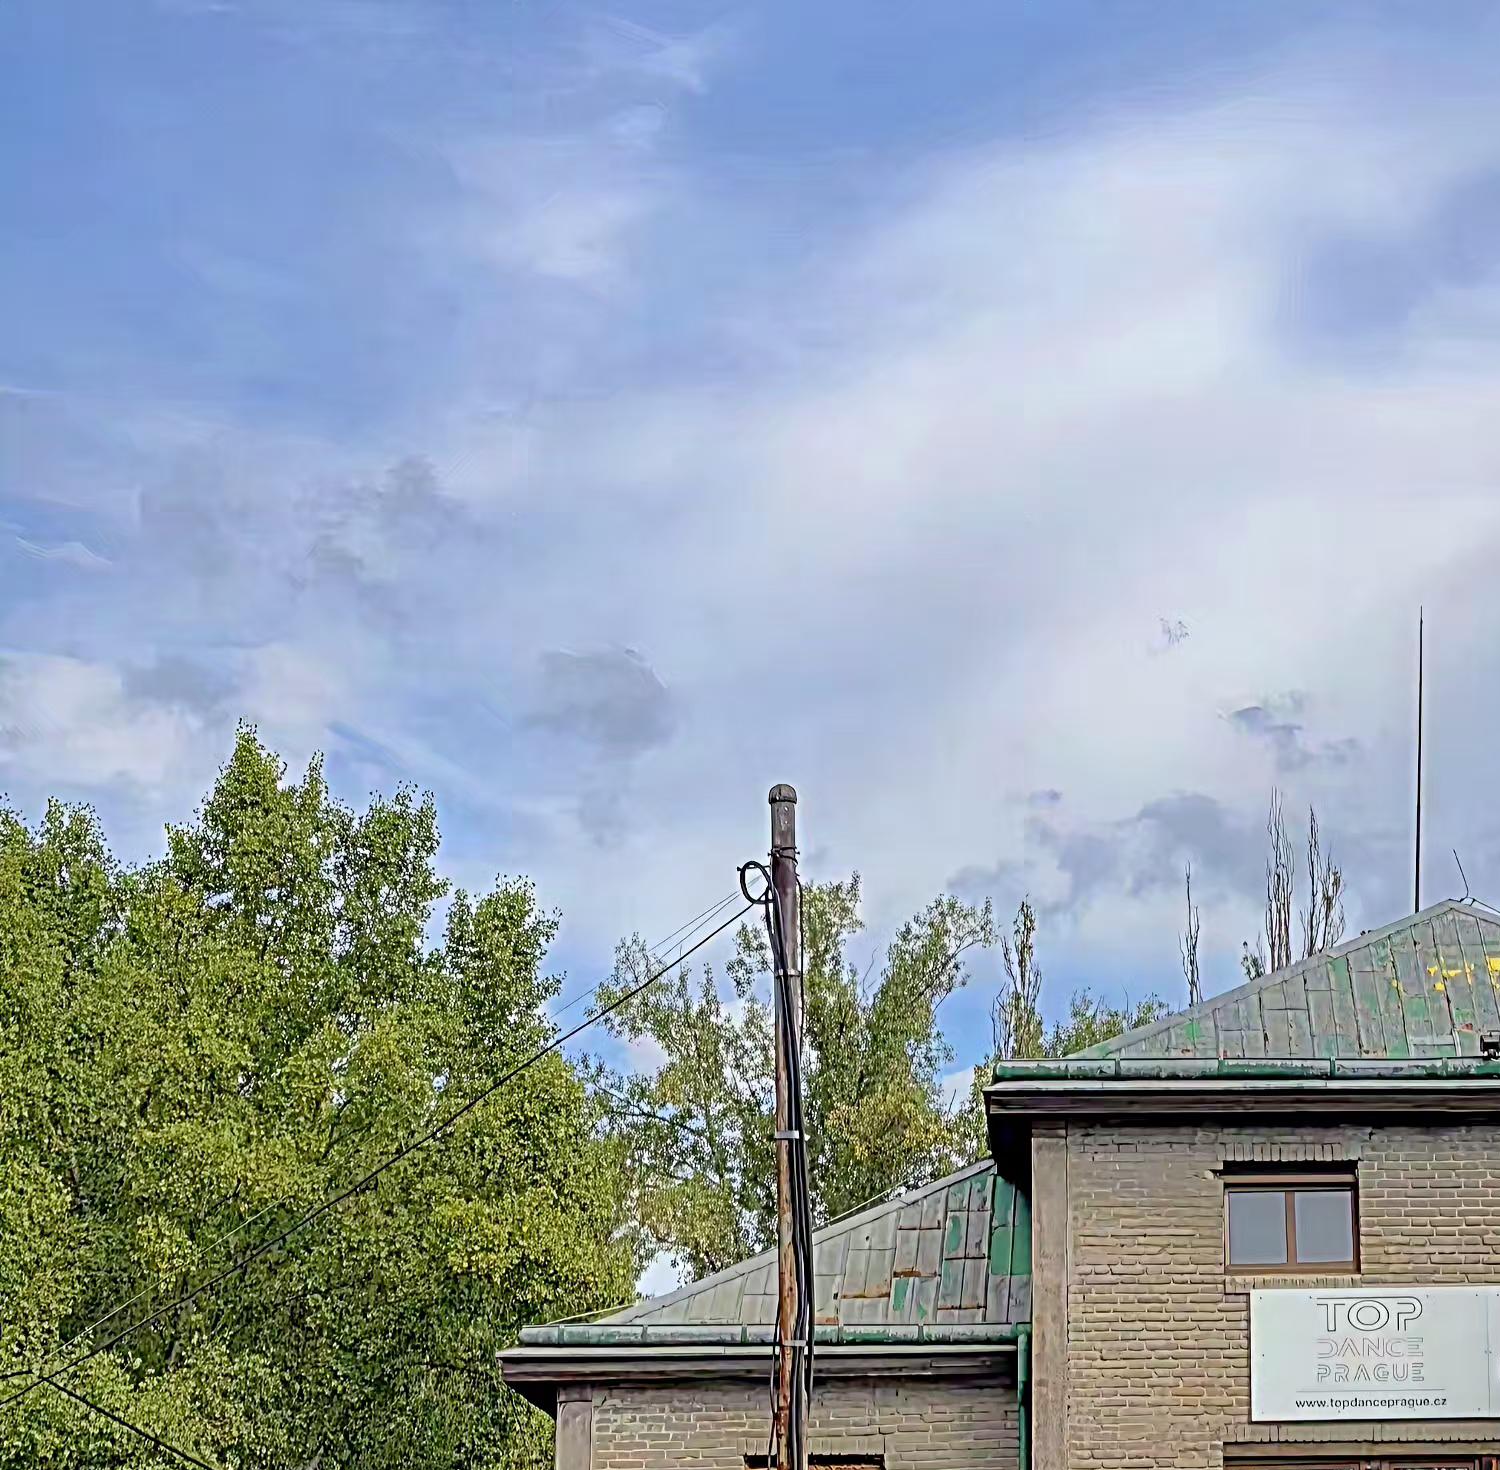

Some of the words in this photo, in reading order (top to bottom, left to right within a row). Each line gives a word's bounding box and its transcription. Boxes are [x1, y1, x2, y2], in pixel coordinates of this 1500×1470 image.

[1316, 1296, 1423, 1332] TOP
[1317, 1336, 1424, 1357] DANCE
[1317, 1363, 1425, 1383] PRAGUE
[1295, 1396, 1448, 1409] www.topdanceprague.cz
